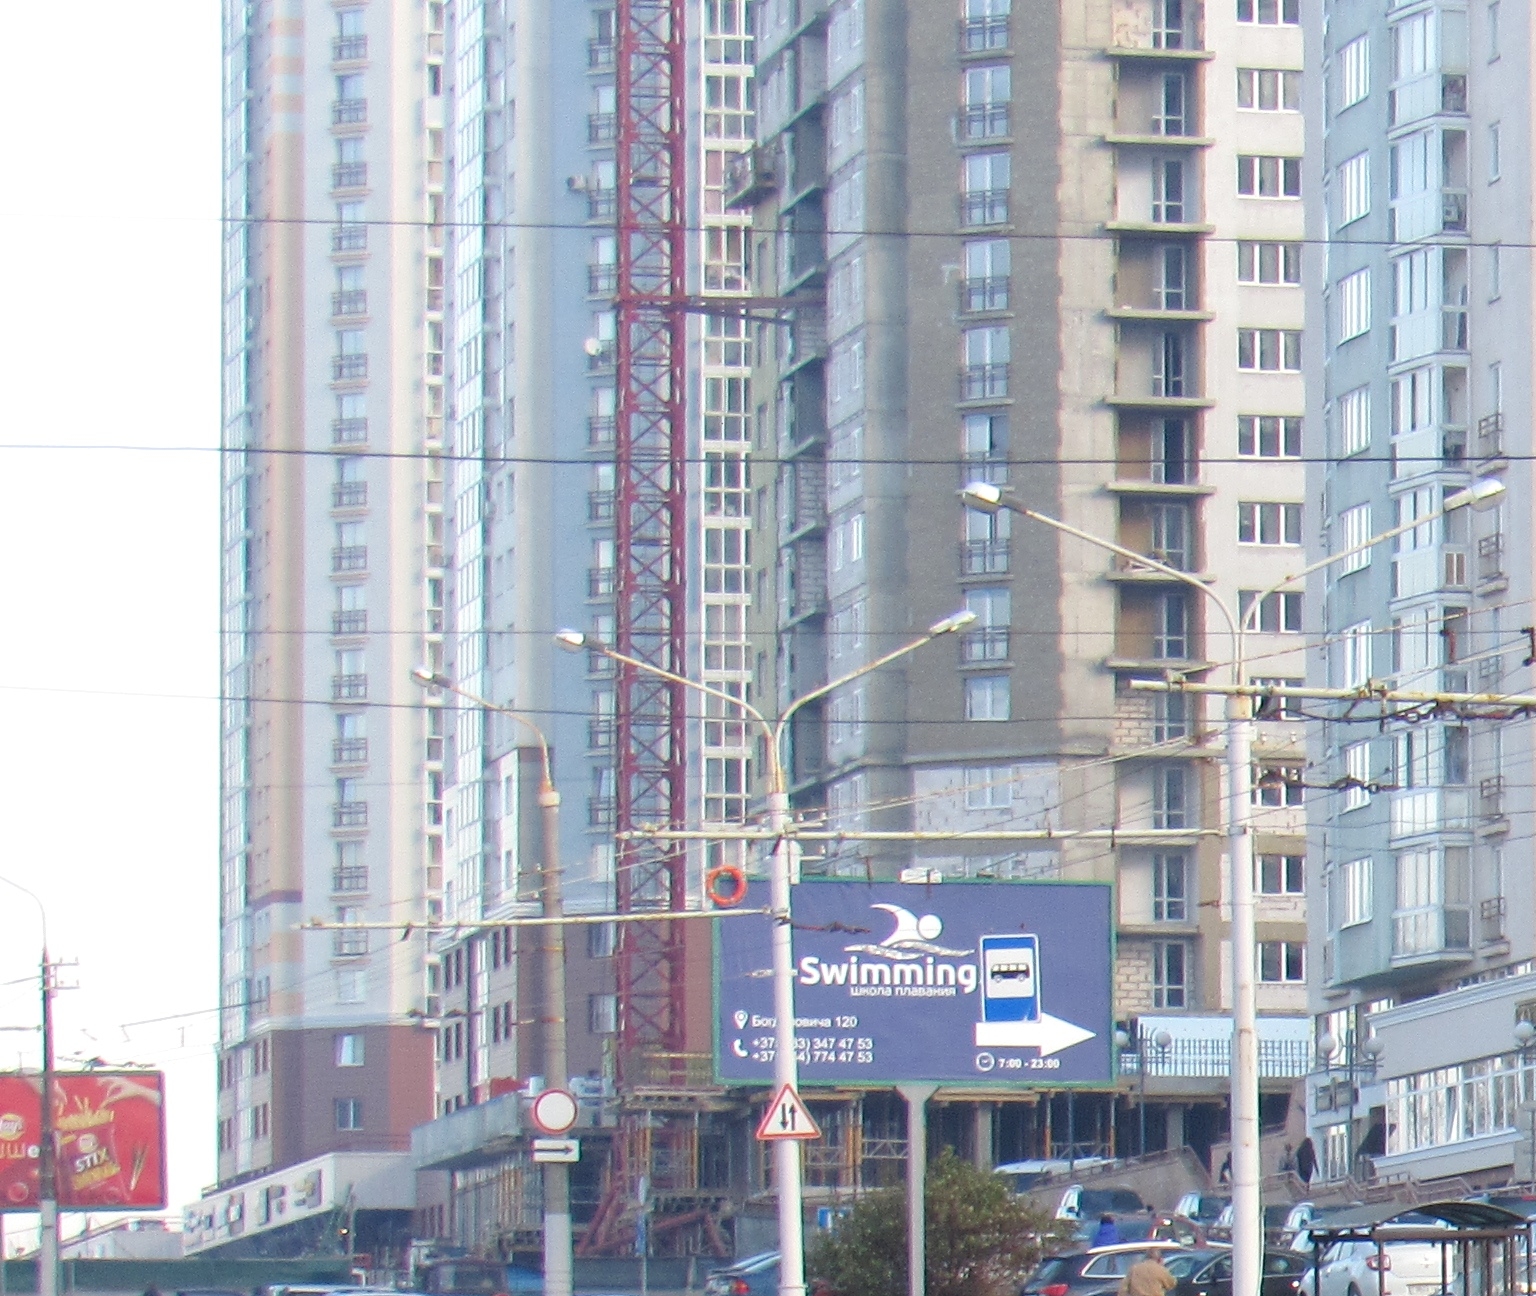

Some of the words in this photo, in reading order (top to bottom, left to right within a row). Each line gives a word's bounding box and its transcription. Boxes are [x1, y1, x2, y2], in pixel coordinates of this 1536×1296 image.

[800, 956, 979, 994] Swimming
[850, 986, 892, 997] школа
[895, 985, 956, 998] плавания
[835, 1015, 858, 1028] 120
[752, 1037, 777, 1049] +37
[813, 1037, 836, 1050] 347
[838, 1037, 854, 1050] 47
[857, 1037, 873, 1050] 53
[752, 1051, 777, 1063] +37
[813, 1051, 836, 1063] 774
[838, 1051, 854, 1063] 47
[857, 1051, 873, 1063] 53
